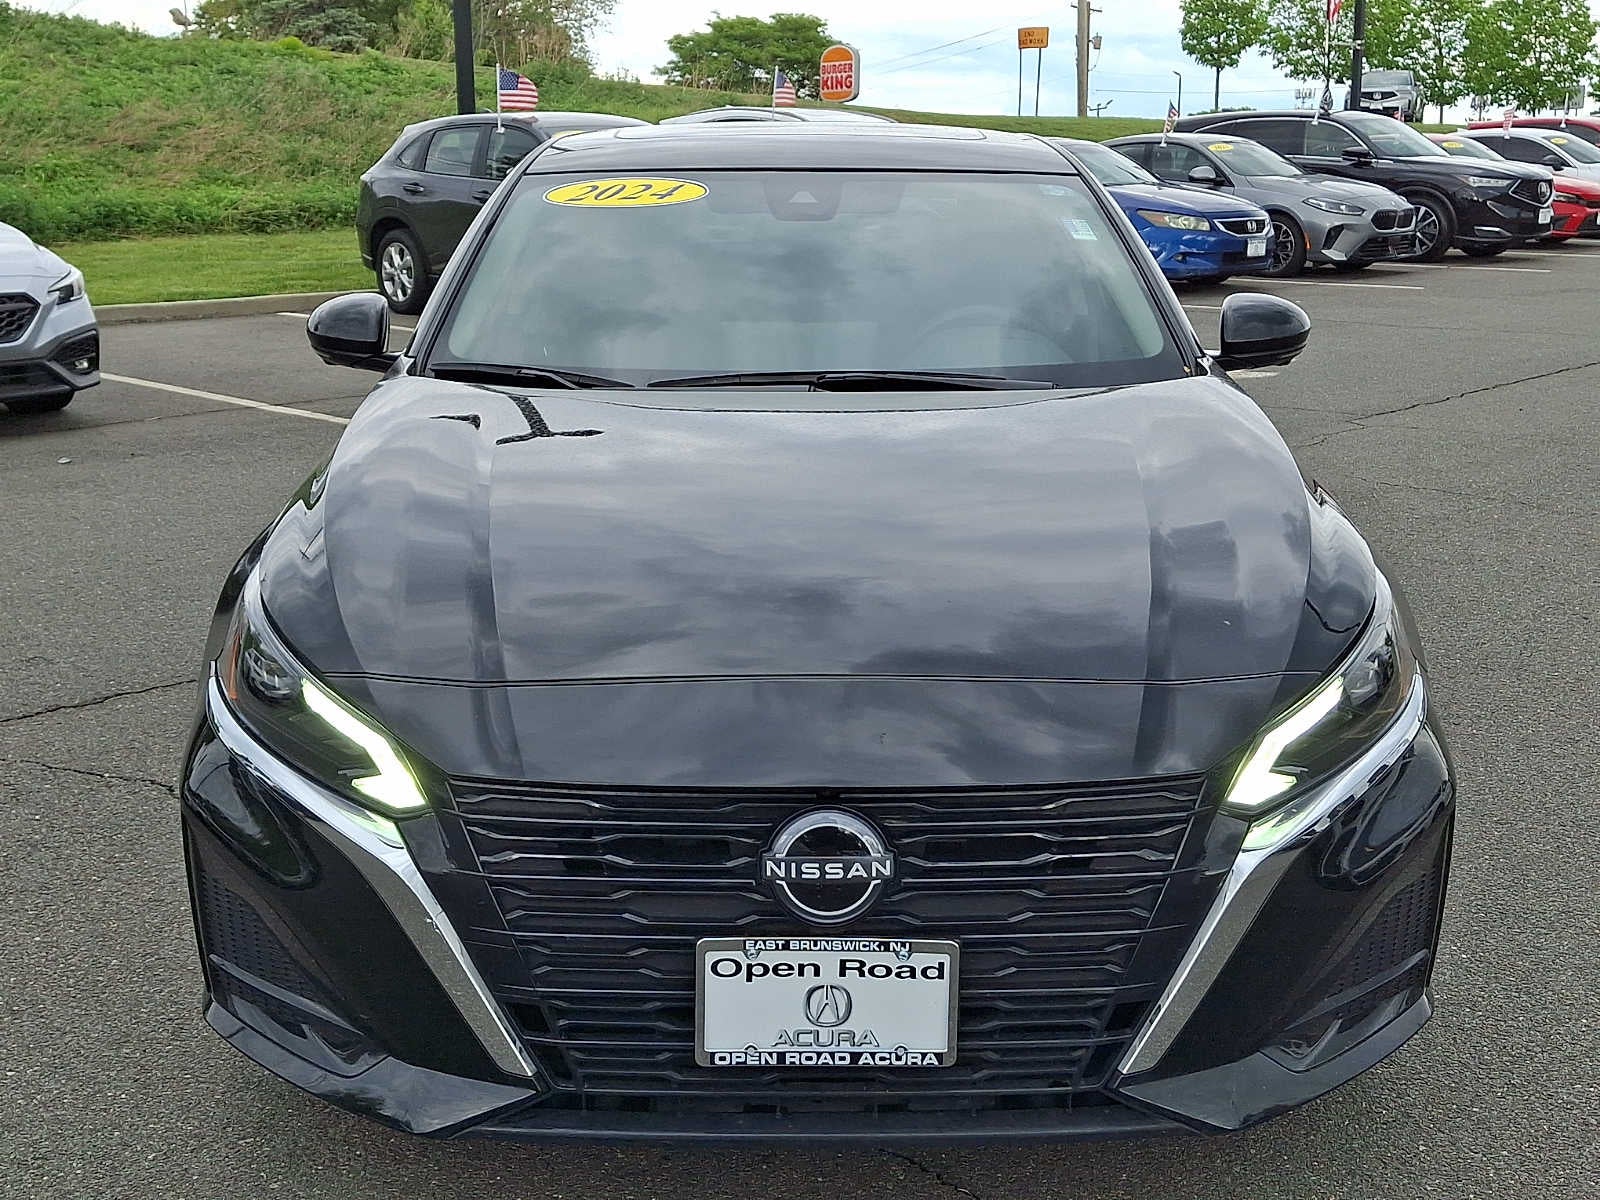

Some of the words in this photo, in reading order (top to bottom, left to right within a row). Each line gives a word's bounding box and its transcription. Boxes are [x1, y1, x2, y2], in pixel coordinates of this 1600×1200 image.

[821, 63, 853, 75] BURGER
[821, 74, 853, 90] KING
[564, 183, 686, 202] 2024
[766, 860, 891, 879] NISSAN
[745, 940, 785, 951] EAST
[789, 940, 885, 952] BRUNSWICK,
[889, 942, 910, 953] NJ
[710, 957, 821, 983] Open
[838, 958, 946, 980] Road
[771, 1029, 880, 1047] ACURA
[714, 1052, 777, 1065] OPEN
[785, 1053, 851, 1065] ROAD
[858, 1053, 940, 1065] ACURA
